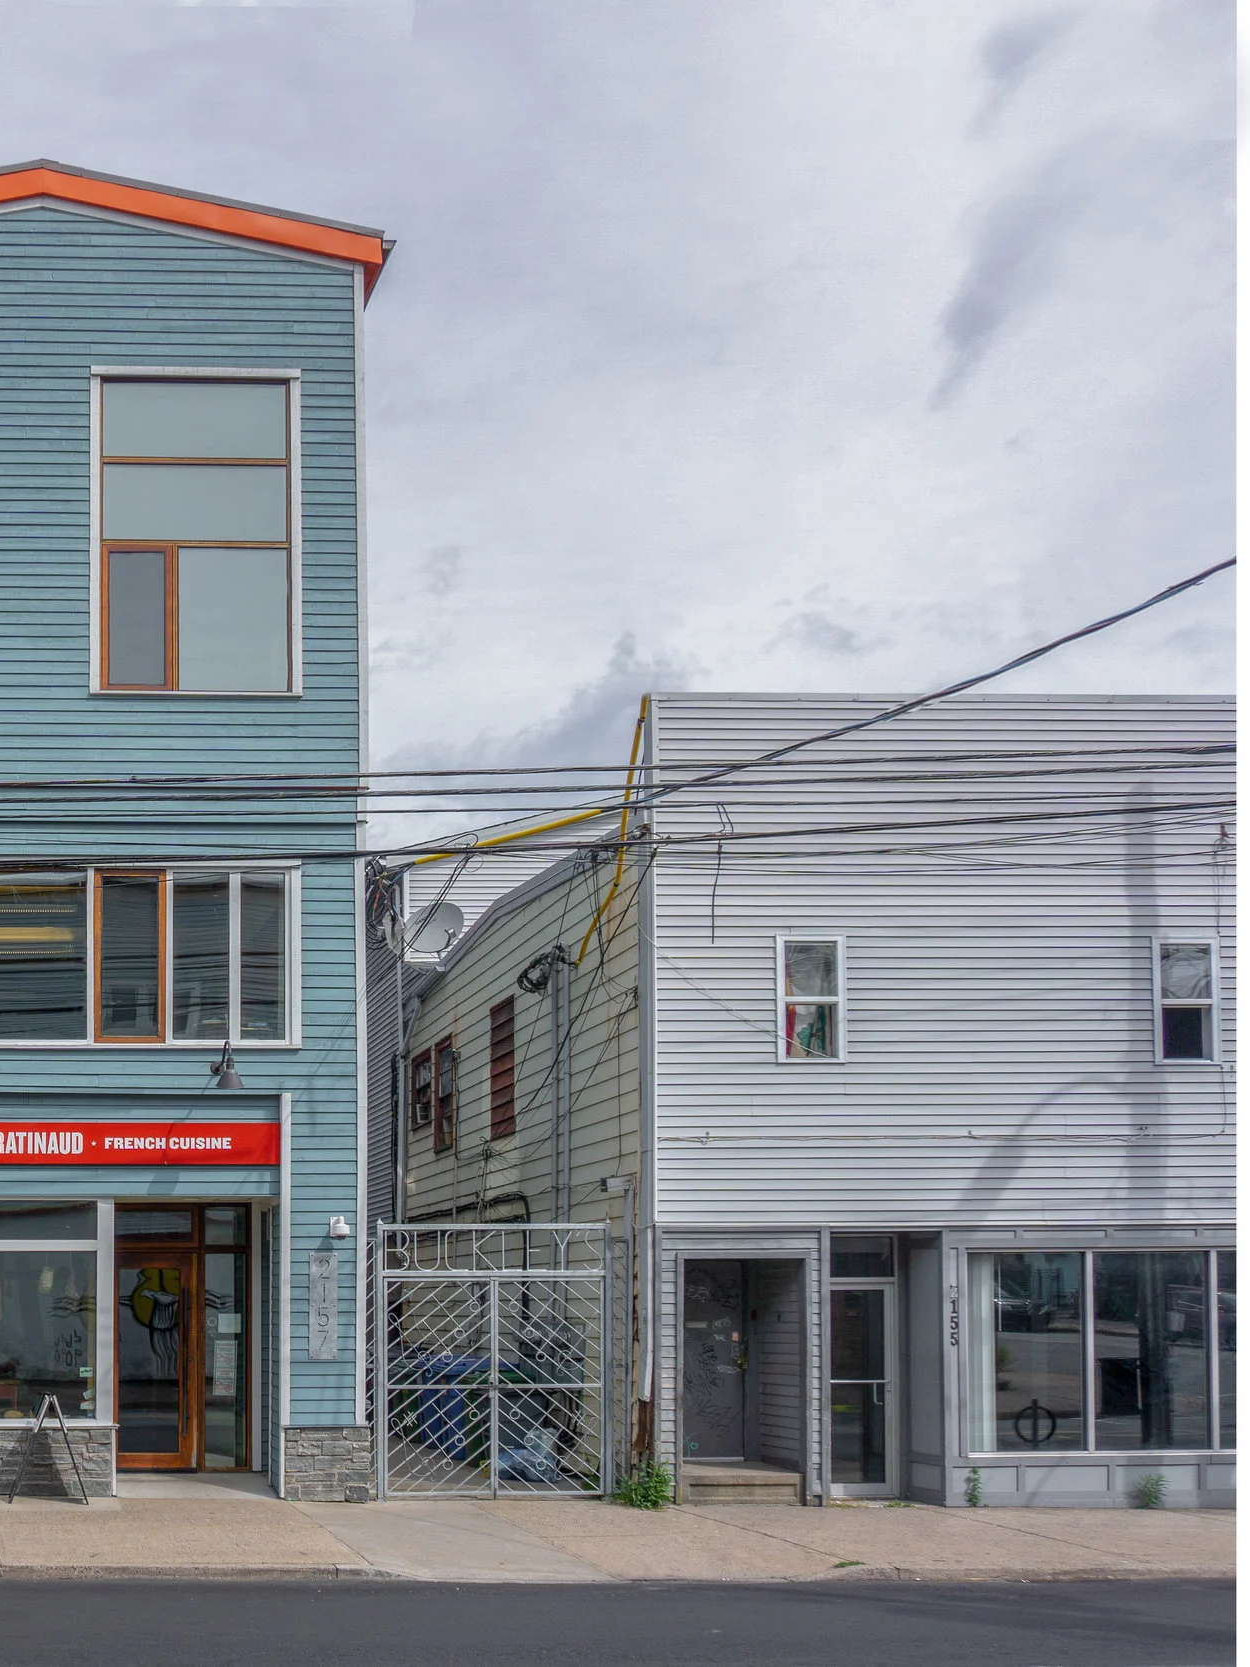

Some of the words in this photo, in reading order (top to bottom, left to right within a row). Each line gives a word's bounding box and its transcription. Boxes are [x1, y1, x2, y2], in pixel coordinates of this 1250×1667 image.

[104, 1137, 166, 1150] FRENCH
[169, 1137, 232, 1150] CUISINE
[384, 1230, 603, 1272] BUCKLEY'S
[317, 1258, 331, 1351] 2157
